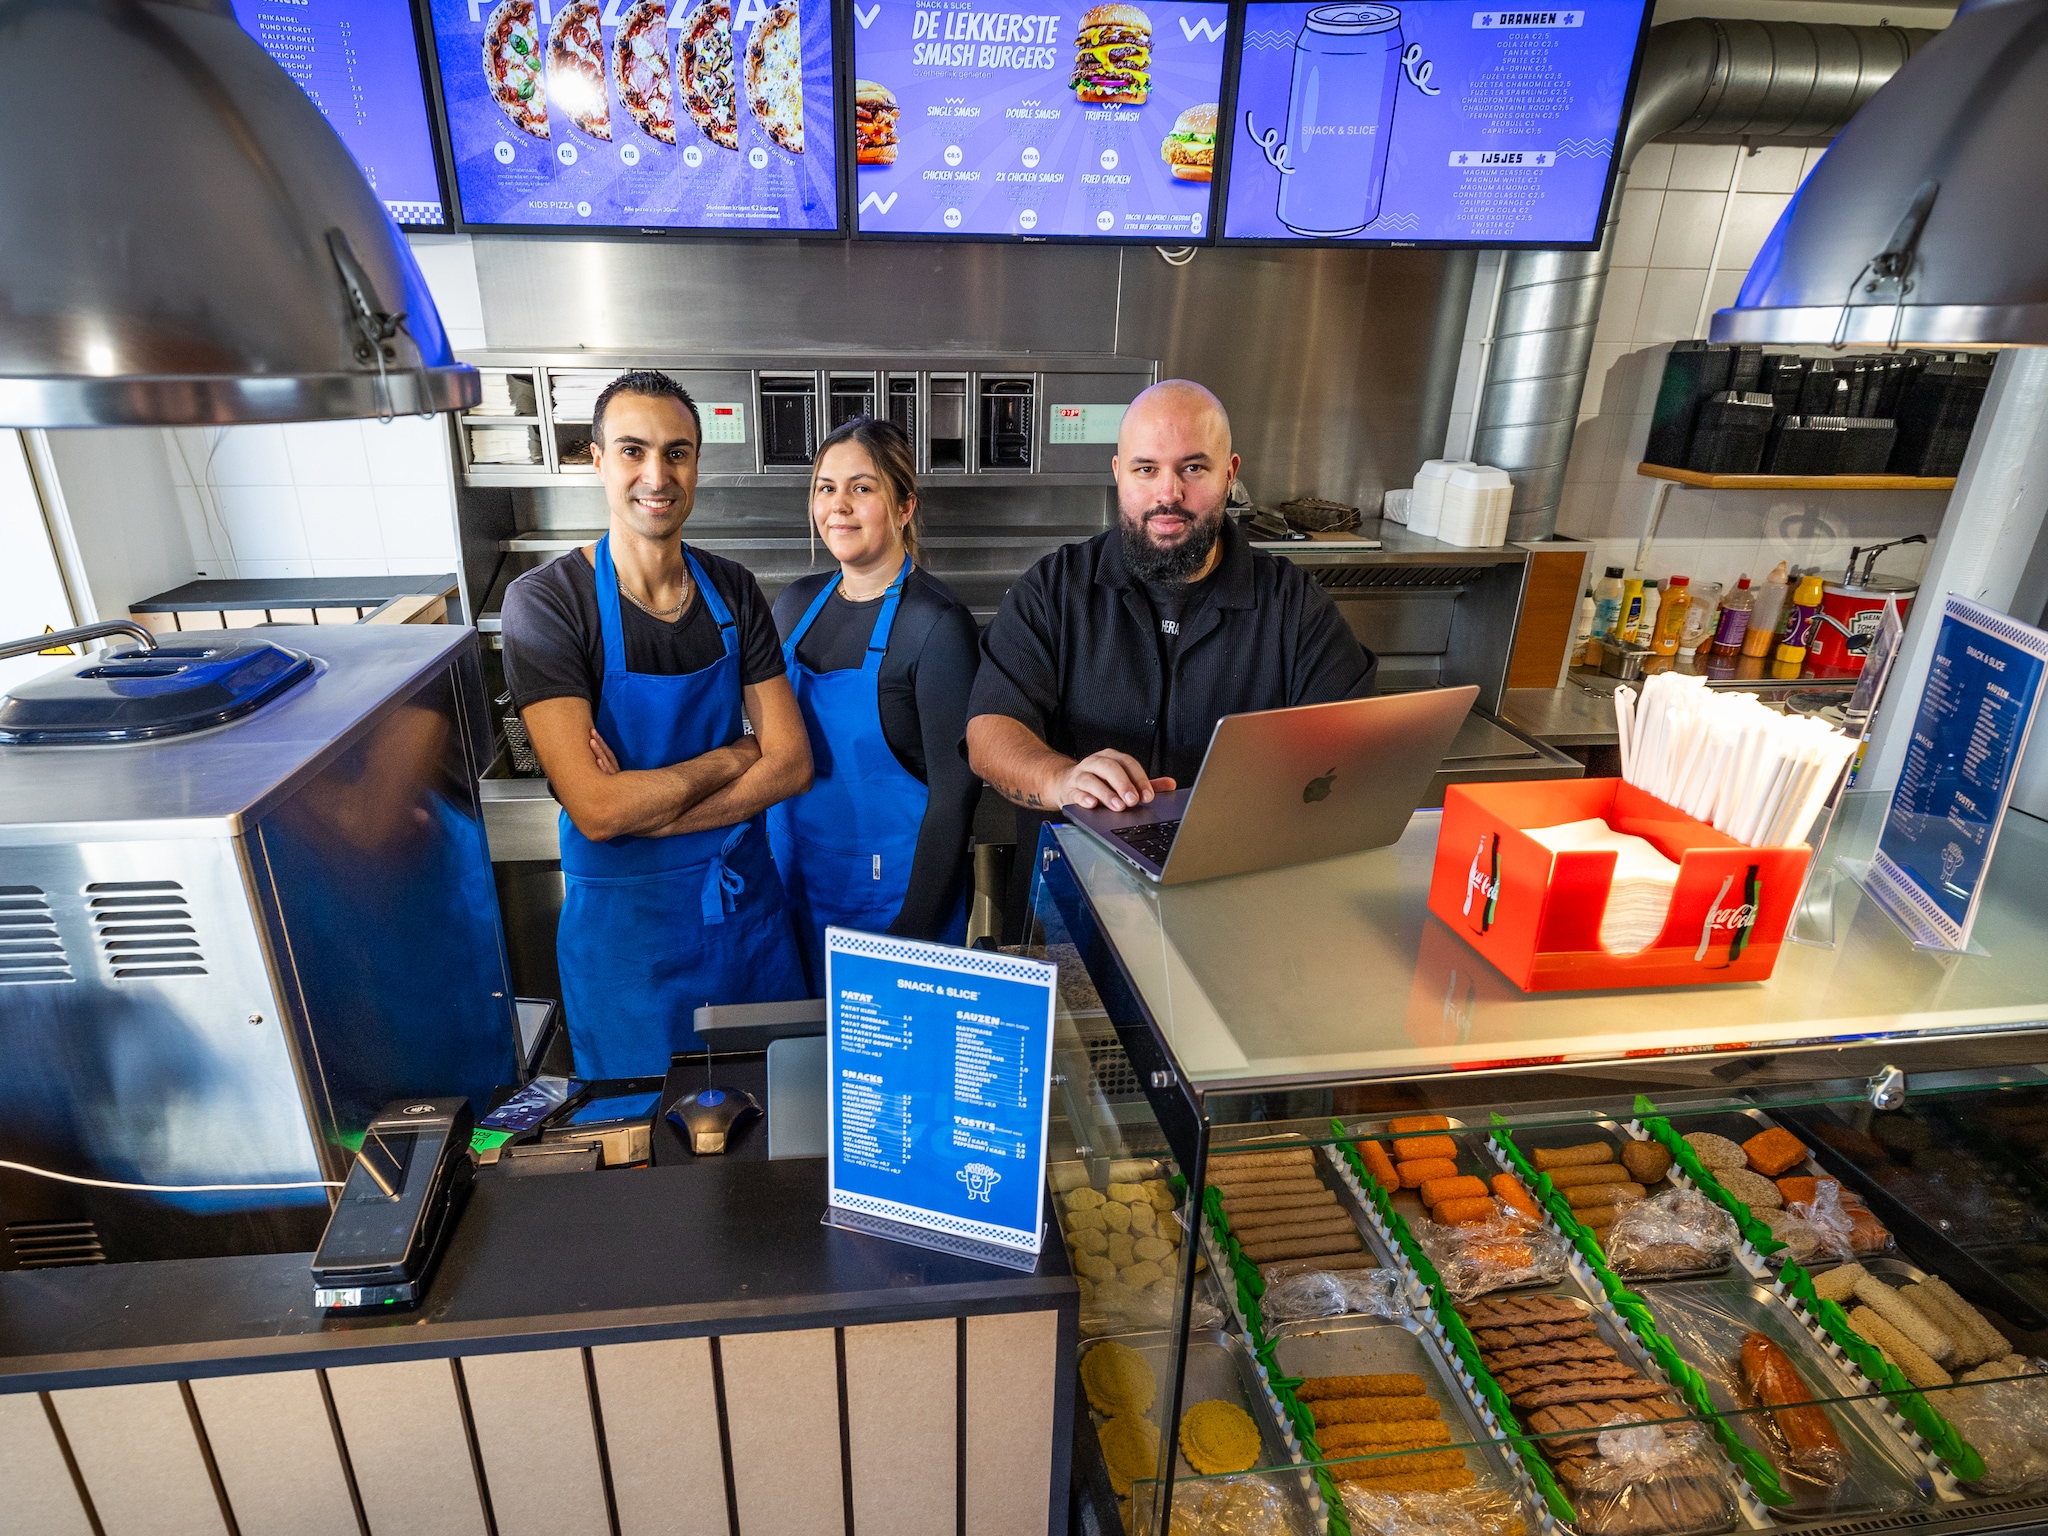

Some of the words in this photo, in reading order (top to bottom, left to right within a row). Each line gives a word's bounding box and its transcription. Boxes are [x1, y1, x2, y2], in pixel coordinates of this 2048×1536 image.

[258, 14, 299, 23] FRIKANDEL
[1500, 13, 1556, 25] DRANKEN
[283, 26, 312, 34] KROKET
[912, 11, 941, 39] DE
[944, 12, 1060, 44] LEKKERSTE
[287, 35, 315, 43] KROKET
[264, 42, 315, 52] KAASSOUFFLE
[912, 42, 975, 66] SMASH
[978, 45, 1057, 70] BURGERS
[927, 106, 952, 117] SINGLE
[954, 107, 980, 117] SMASH
[1006, 109, 1033, 119] DOUBLE
[1035, 110, 1061, 120] SMASH
[1085, 111, 1112, 121] TRUFFEL
[1114, 112, 1139, 122] SMASH
[496, 119, 528, 147] Margherita
[1302, 126, 1335, 135] SNACK
[1338, 127, 1345, 135] &
[1347, 126, 1376, 134] SLICE
[566, 129, 596, 152] Pepperoni
[631, 132, 661, 156] Prosciutto
[697, 139, 717, 156] Funghi
[766, 147, 796, 166] Formaggi
[1481, 153, 1523, 163] IJSJES
[923, 171, 953, 180] CHICKEN
[955, 171, 980, 181] SMASH
[996, 172, 1006, 182] 2X
[1007, 173, 1037, 183] CHICKEN
[1038, 174, 1064, 183] SMASH
[1081, 175, 1100, 183] FRIED
[1101, 175, 1131, 184] CHICKEN
[1161, 619, 1180, 636] HERA
[897, 979, 934, 993] SNACK
[936, 986, 944, 995] &
[946, 987, 978, 1001] SLICE
[841, 990, 873, 1002] PATAT
[956, 1011, 1000, 1025] SAUZEN
[842, 1069, 883, 1084] SNACKS
[954, 1116, 995, 1131] TOSTI'S
[953, 1129, 970, 1137] KAAS
[989, 1147, 1006, 1156] KAAS
